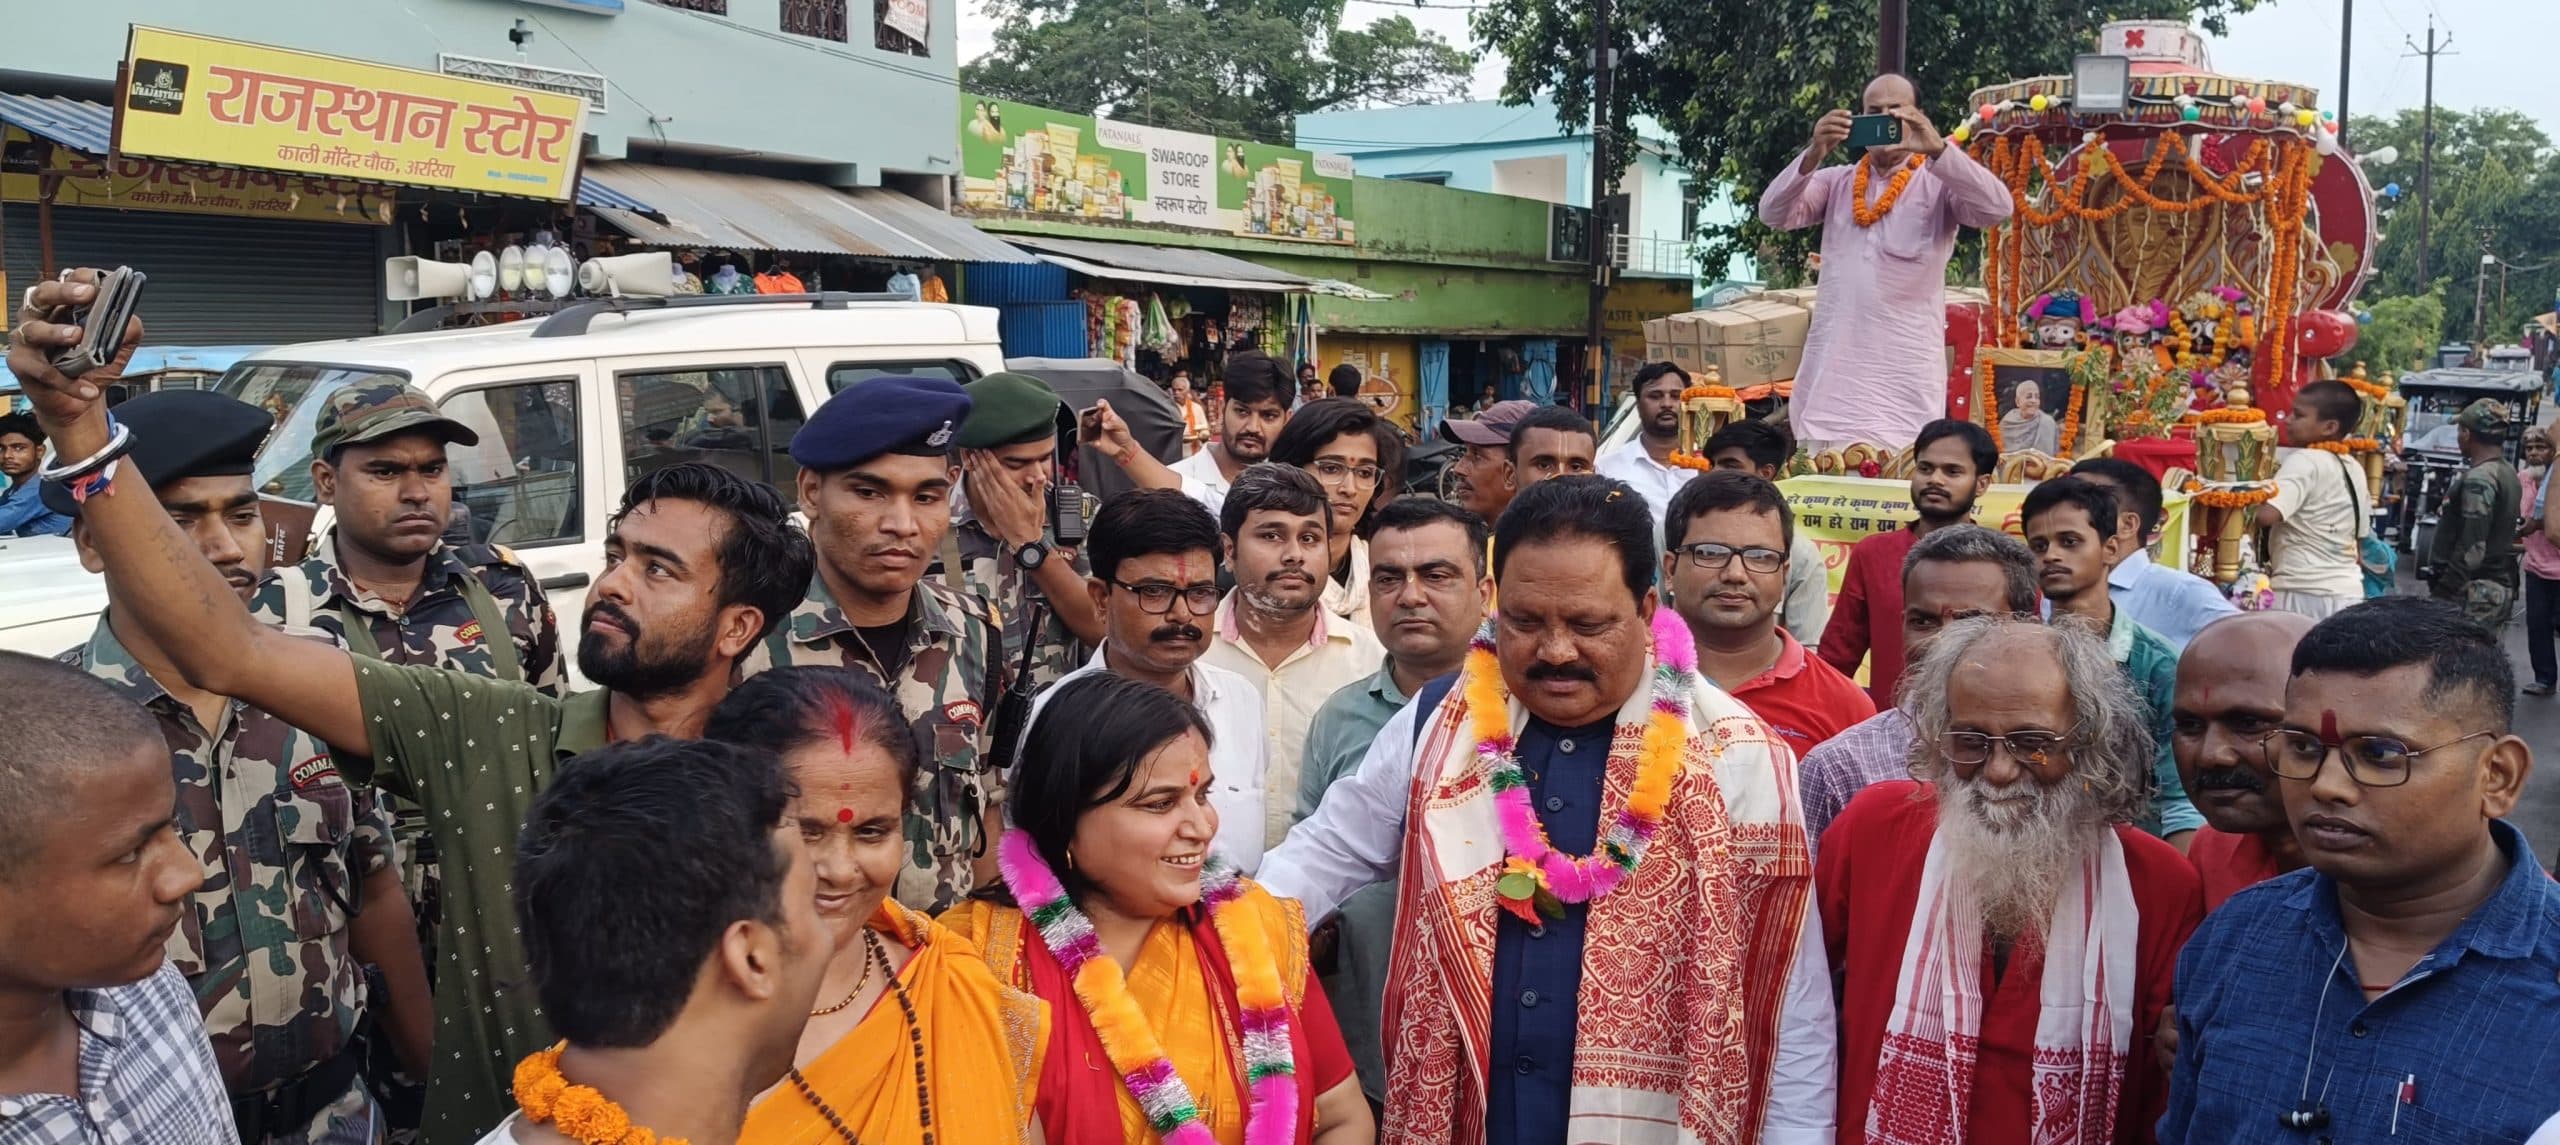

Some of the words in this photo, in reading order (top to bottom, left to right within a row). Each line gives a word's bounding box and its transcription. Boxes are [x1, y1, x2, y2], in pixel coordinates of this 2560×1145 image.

[206, 66, 458, 149] राजस्थान
[464, 96, 572, 163] स्टोर
[277, 143, 320, 165] काली
[323, 145, 361, 169] मंदिर
[363, 151, 400, 174] चौक,
[404, 157, 456, 179] अररिया
[1152, 148, 1208, 168] SWAROOP
[1162, 171, 1200, 188] STORE
[131, 191, 169, 204] काली
[1155, 196, 1184, 213] स्वरूप
[1187, 195, 1208, 215] स्टोर
[1803, 496, 1830, 508] कृष्ण
[1833, 495, 1847, 507] हरे
[1850, 500, 1877, 512] कृष्ण
[1881, 501, 1910, 513] कृष्ण
[1803, 514, 1822, 527] राम
[1850, 517, 1869, 531] राम
[1877, 519, 1897, 532] राम
